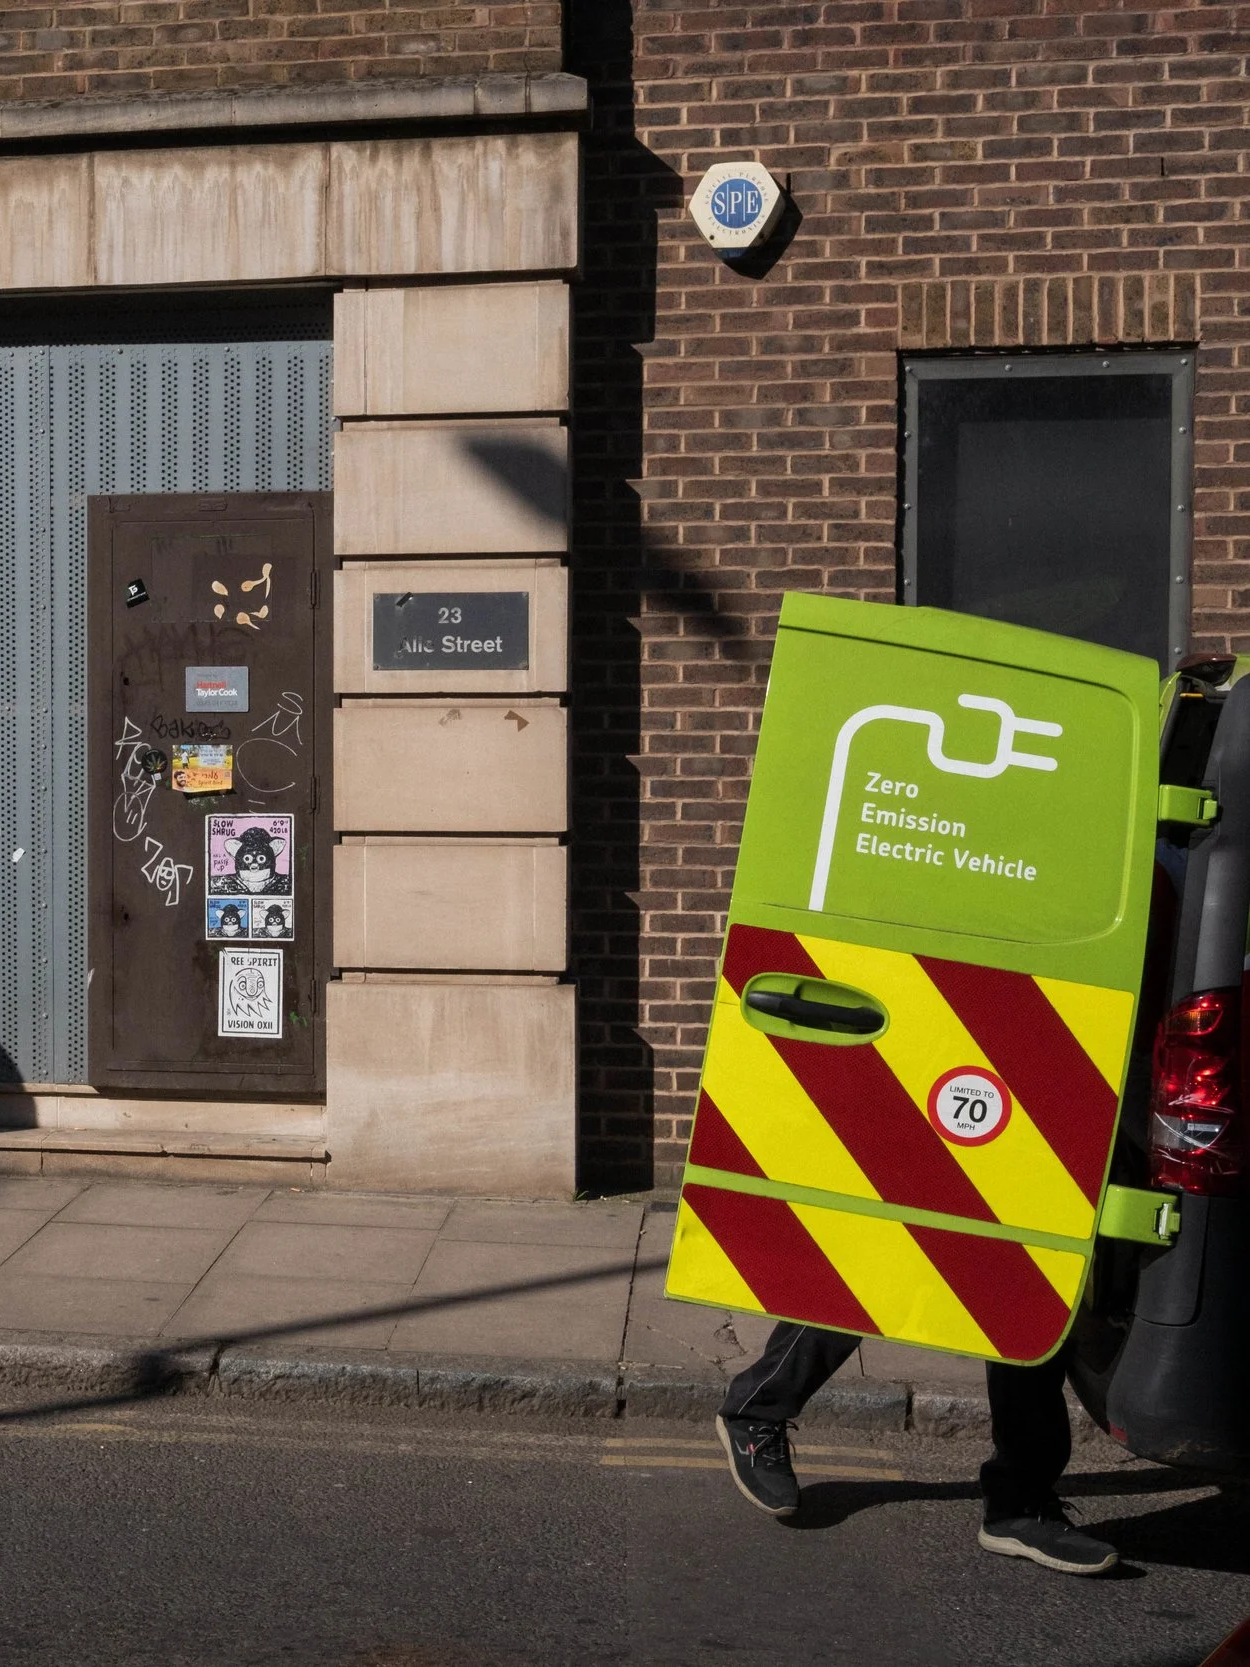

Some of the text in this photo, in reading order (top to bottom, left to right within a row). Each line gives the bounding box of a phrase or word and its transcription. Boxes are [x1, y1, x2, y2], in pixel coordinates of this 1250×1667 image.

[438, 607, 462, 624] 23
[441, 635, 503, 653] Street
[196, 688, 238, 698] Taylor Cook
[865, 771, 919, 798] Zero
[213, 820, 234, 828] SLOW
[861, 802, 966, 838] Emission
[212, 828, 236, 836] SHRUG
[856, 833, 1037, 881] Electric Vehicle
[228, 1020, 254, 1029] VISION
[949, 1085, 995, 1099] LIMITED TO
[952, 1095, 988, 1123] 70
[956, 1122, 976, 1131] MPH
